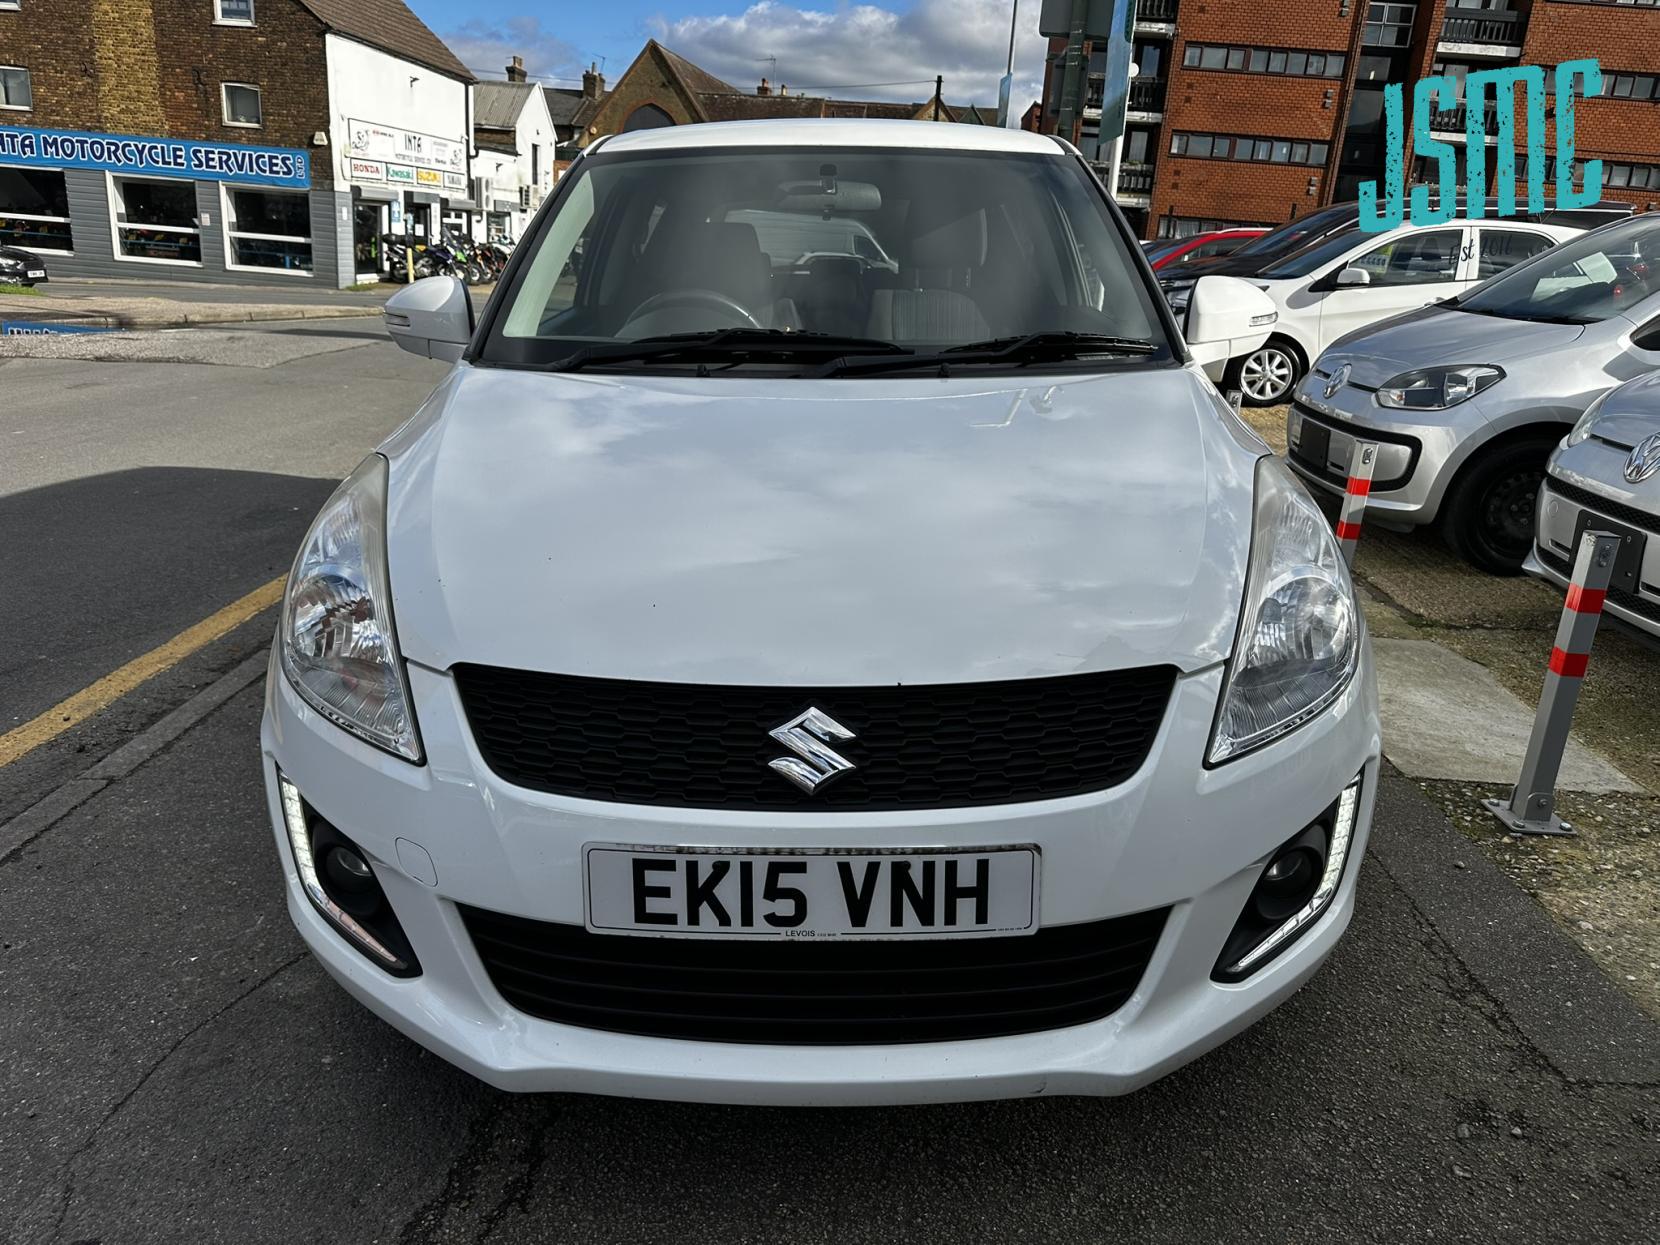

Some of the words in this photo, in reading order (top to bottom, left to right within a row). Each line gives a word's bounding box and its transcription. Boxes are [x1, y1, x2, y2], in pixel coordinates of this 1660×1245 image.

[41, 134, 186, 167] MOTORCYCLE
[191, 146, 294, 178] SERVICES
[295, 155, 306, 179] LTD
[353, 163, 380, 175] HONDA
[632, 858, 808, 927] EK15
[836, 858, 989, 927] VNH
